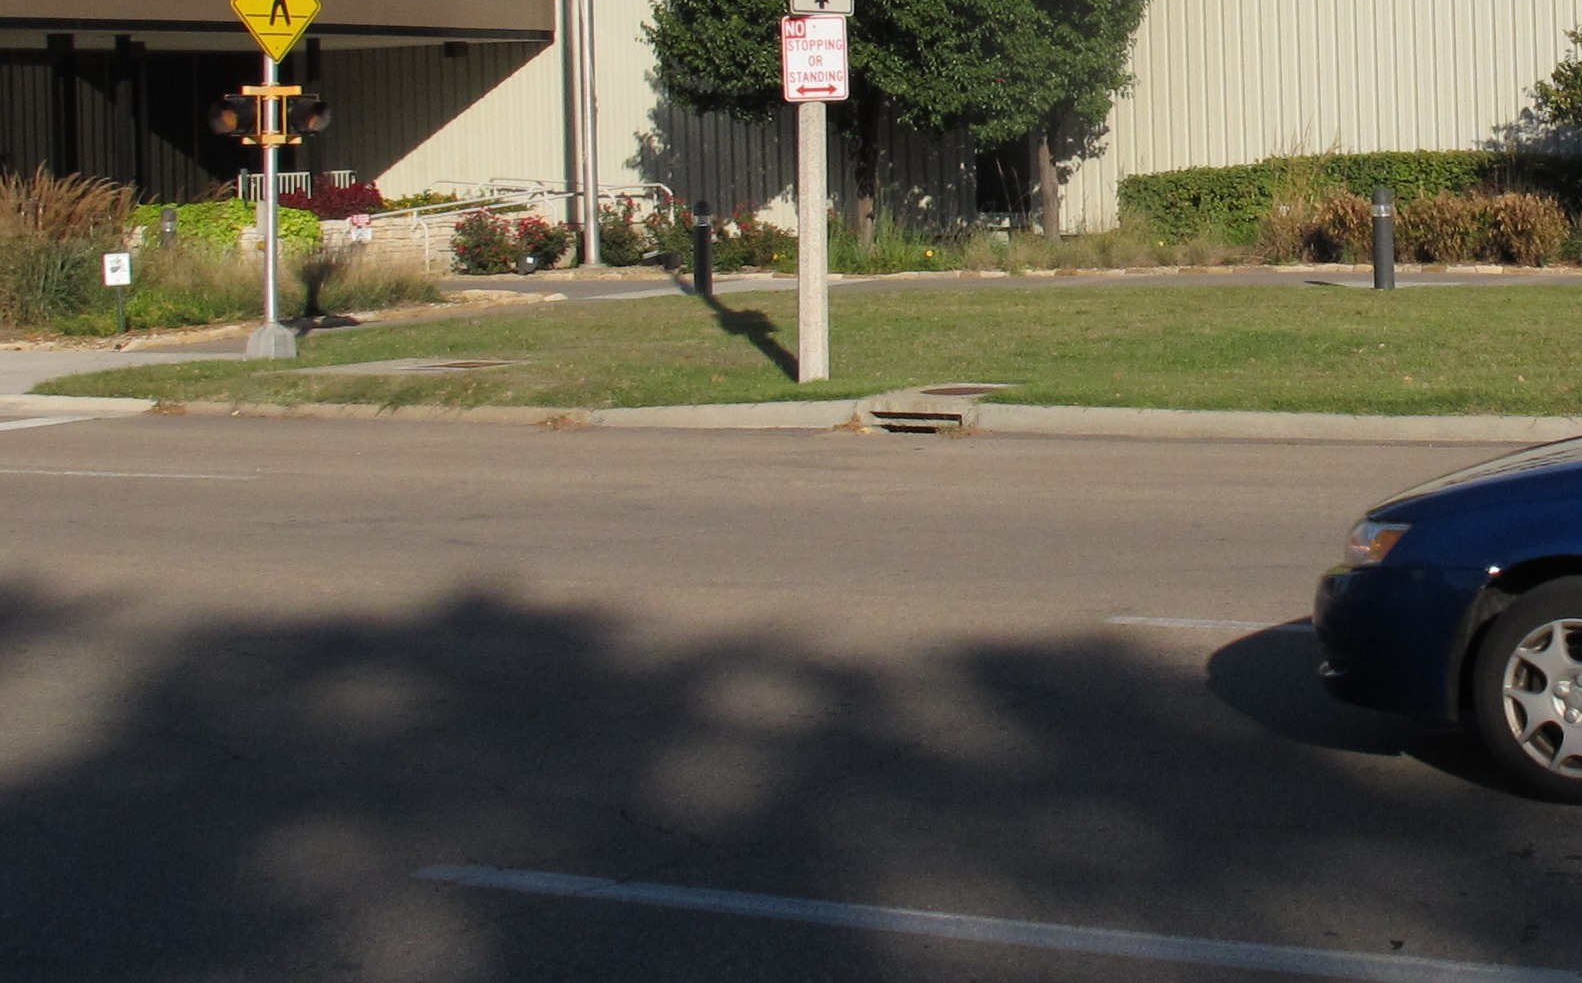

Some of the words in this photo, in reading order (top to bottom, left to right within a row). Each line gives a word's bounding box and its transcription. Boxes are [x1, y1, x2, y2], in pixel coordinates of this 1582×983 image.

[785, 20, 806, 37] NO
[787, 39, 844, 52] STOPPING
[808, 55, 824, 67] OR
[789, 70, 844, 84] STANDING
